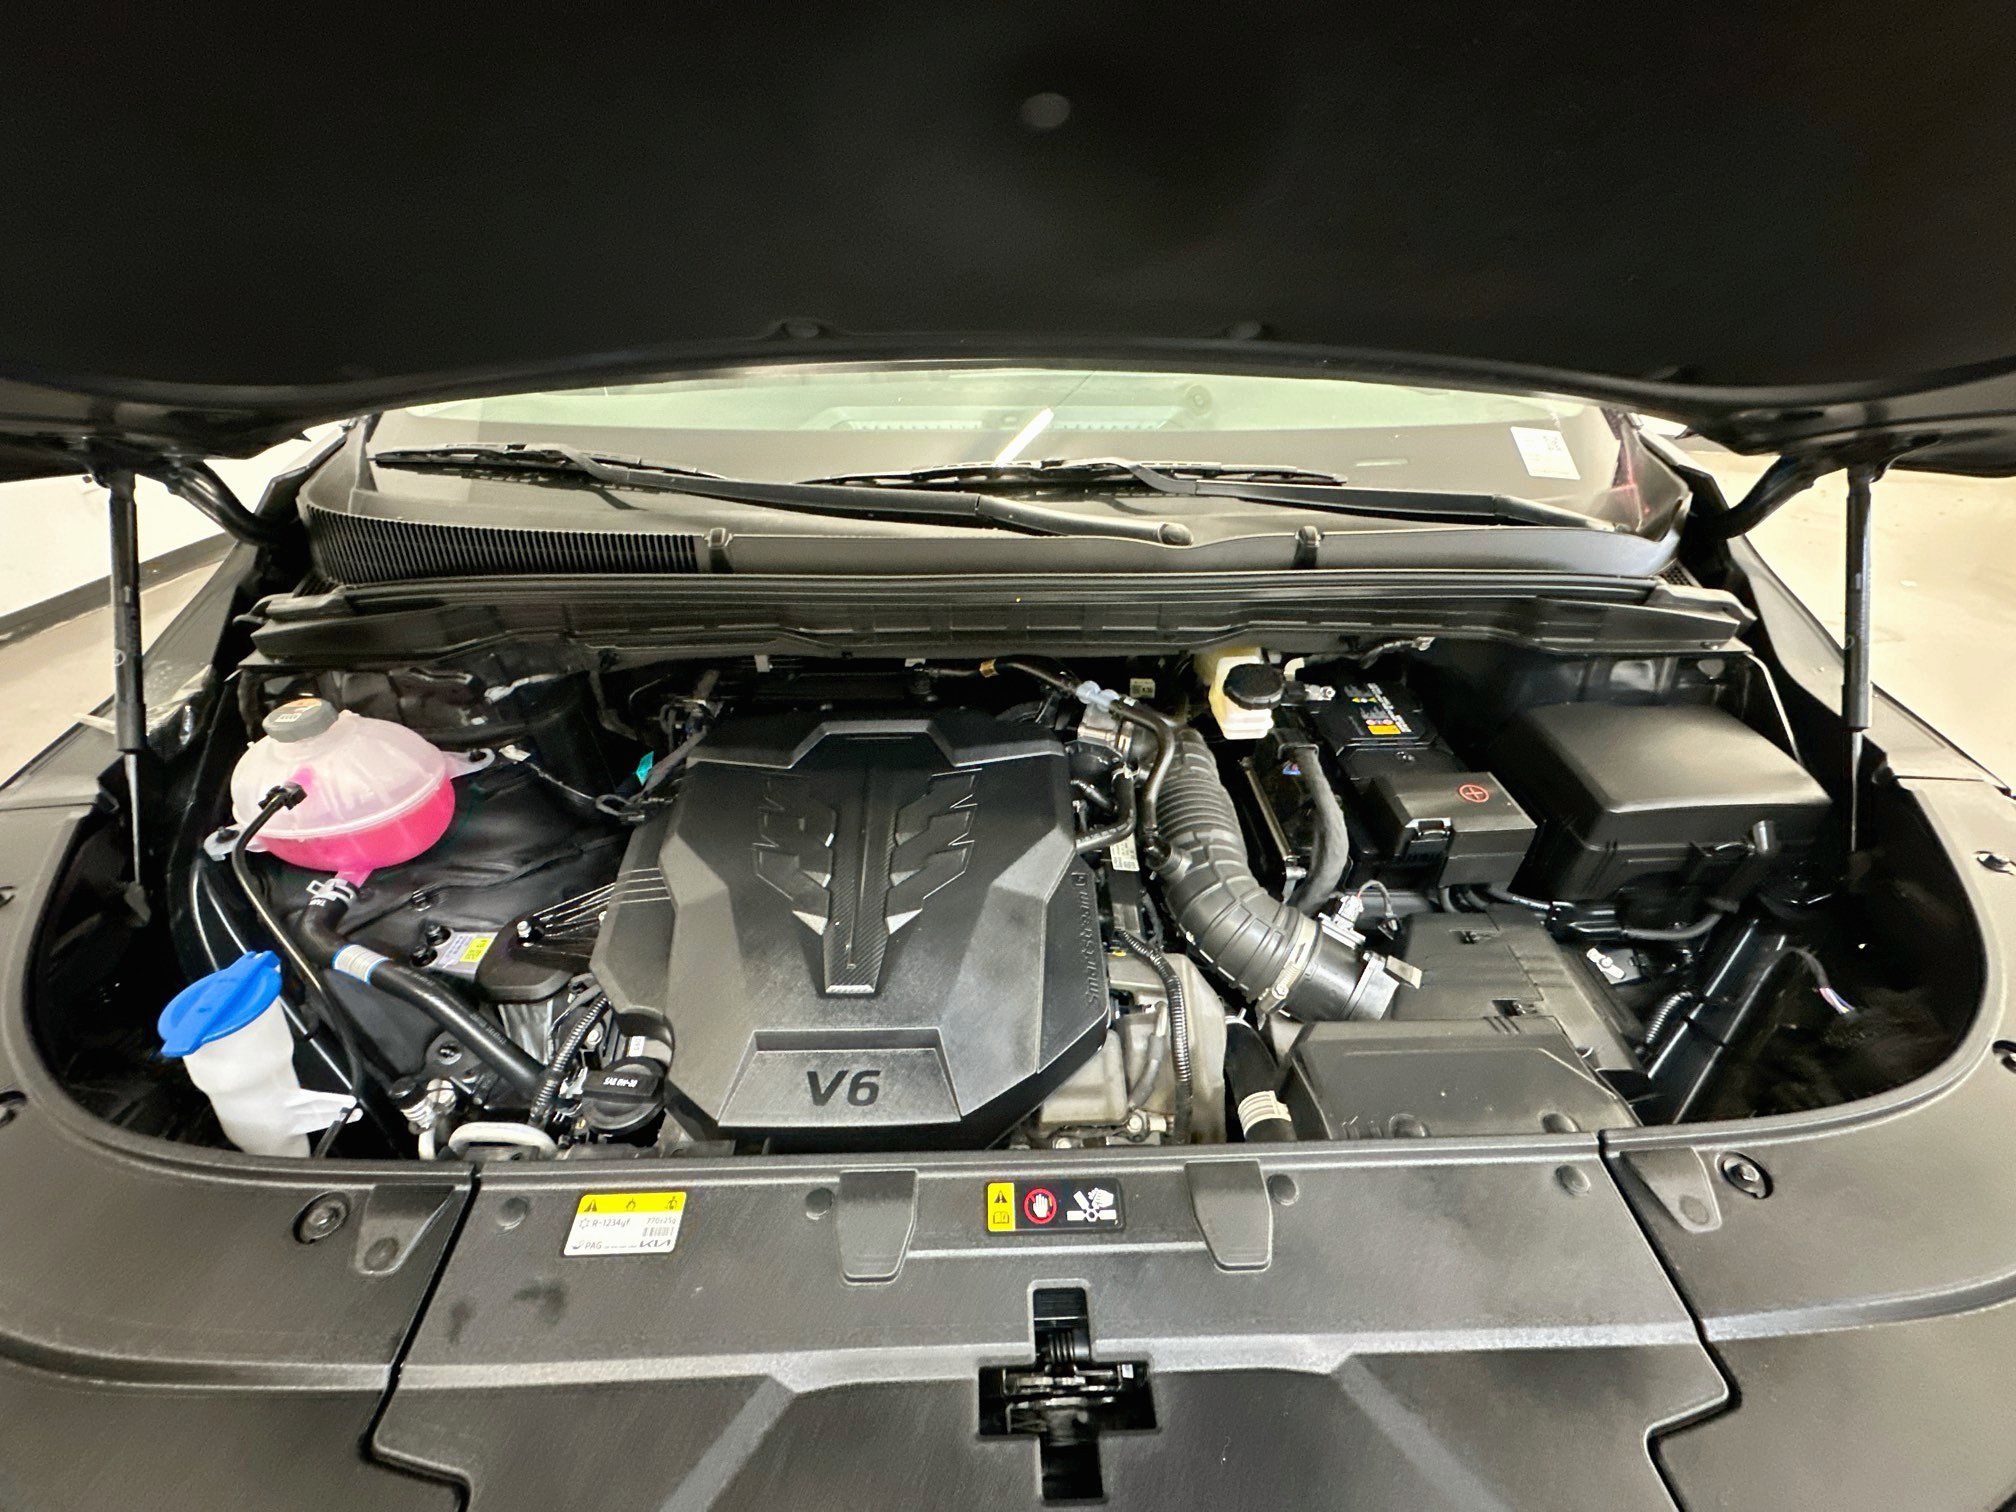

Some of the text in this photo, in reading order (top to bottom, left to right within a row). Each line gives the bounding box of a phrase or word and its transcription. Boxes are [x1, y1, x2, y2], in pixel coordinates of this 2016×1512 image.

[1078, 891, 1100, 1005] Smartstream
[807, 1069, 882, 1107] V6
[592, 1217, 631, 1229] R-1234yf
[584, 1240, 602, 1250] PAG
